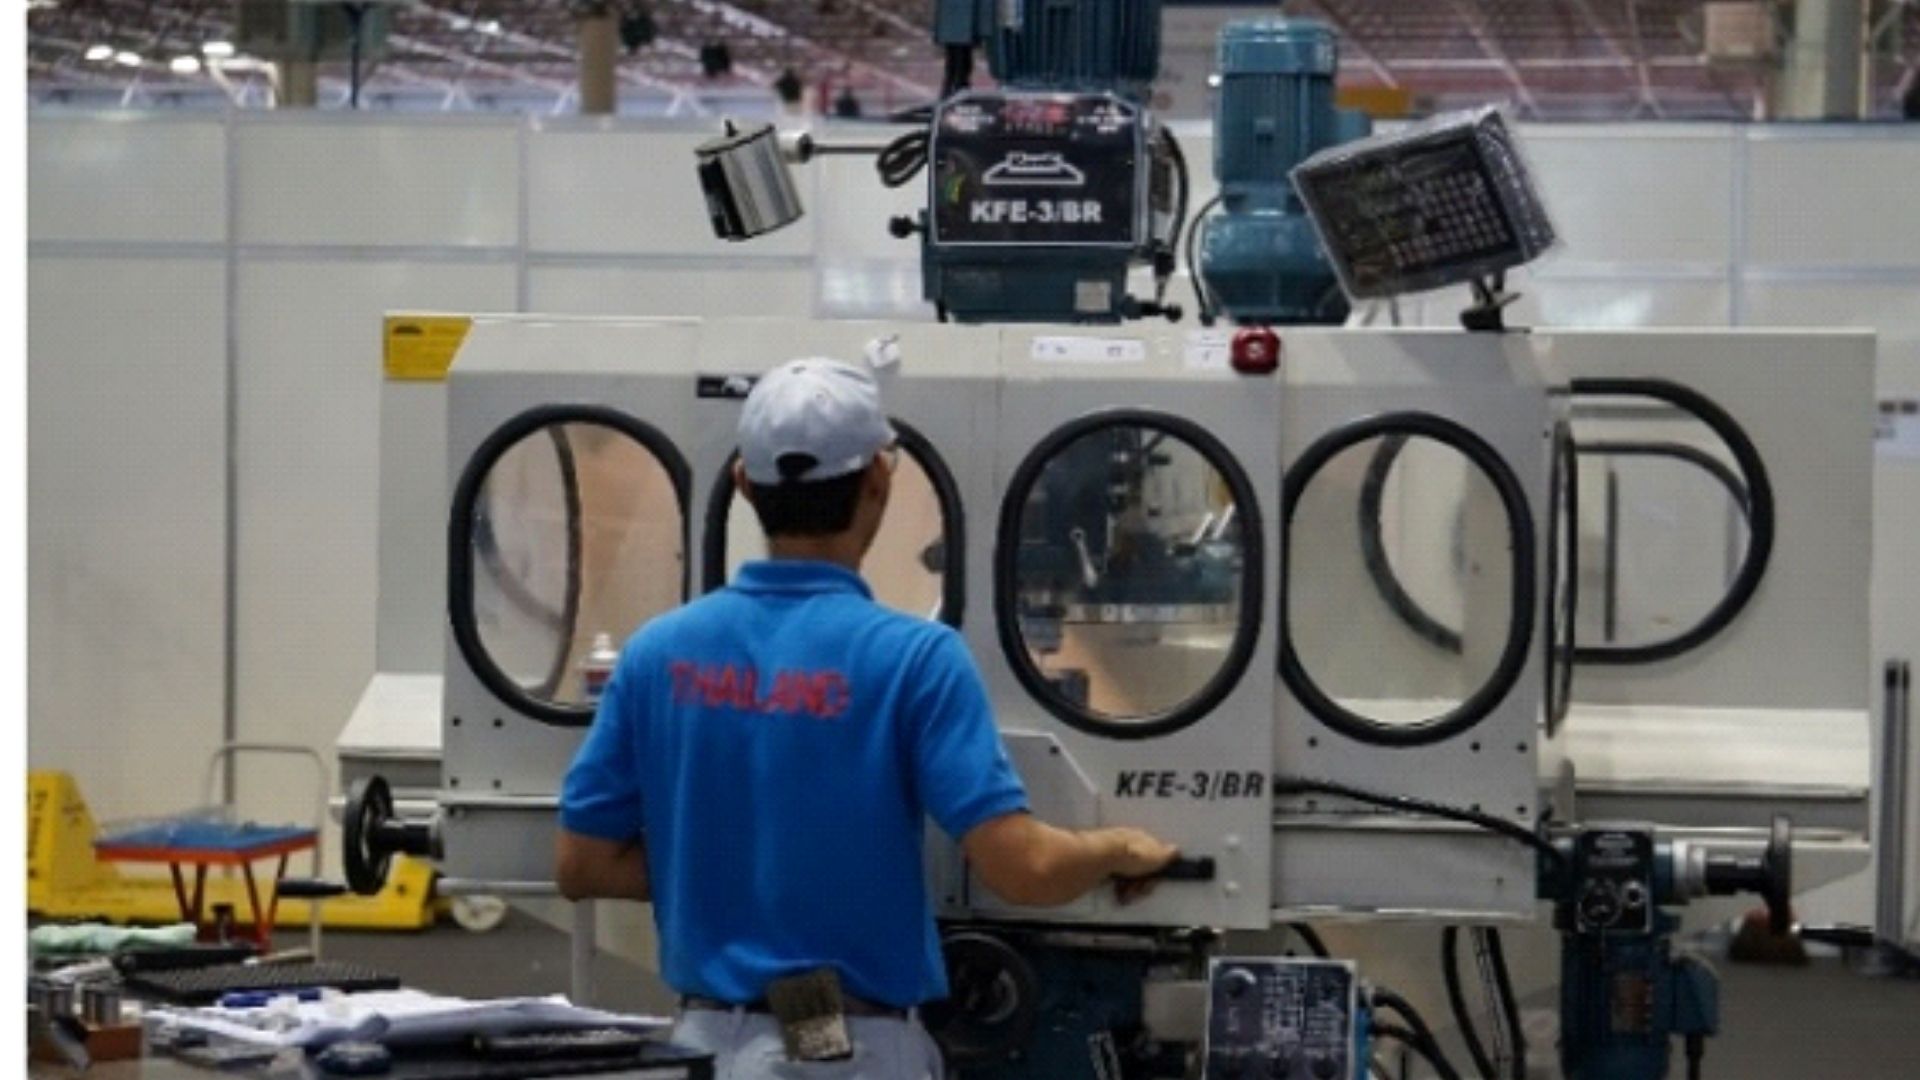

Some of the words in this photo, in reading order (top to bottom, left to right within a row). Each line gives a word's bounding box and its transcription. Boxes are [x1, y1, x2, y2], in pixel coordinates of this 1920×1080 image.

[970, 200, 1102, 223] KFE-3/BR
[669, 661, 849, 718] THAILAND
[1115, 771, 1264, 801] KFE-3/BR
